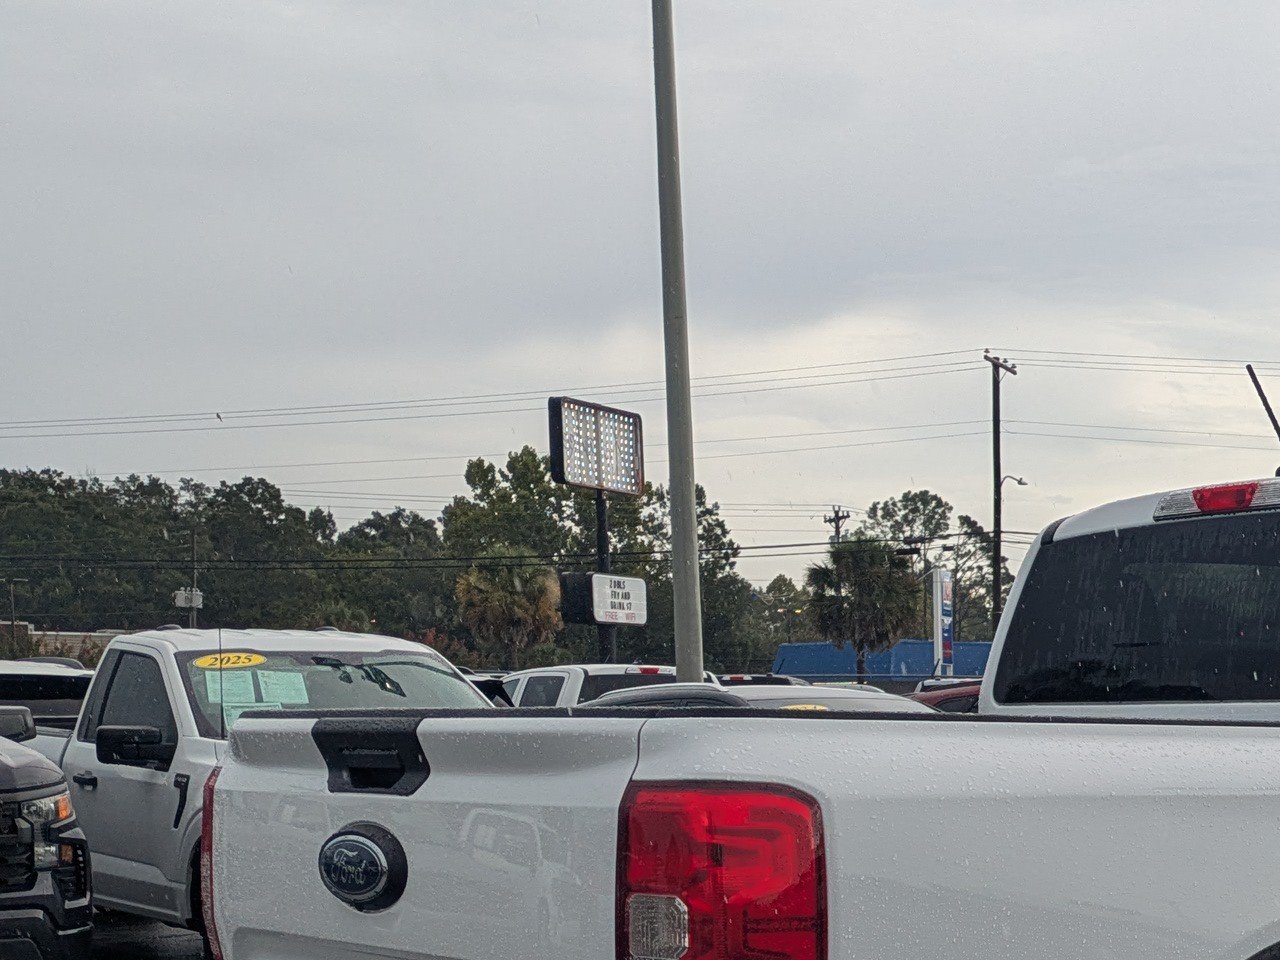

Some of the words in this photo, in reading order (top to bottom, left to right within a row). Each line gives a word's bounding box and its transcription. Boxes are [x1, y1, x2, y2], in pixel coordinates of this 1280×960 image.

[611, 590, 620, 600] FRY
[621, 591, 631, 600] AND
[611, 601, 625, 610] DRINK
[605, 611, 618, 620] FREE
[207, 655, 254, 667] 2025
